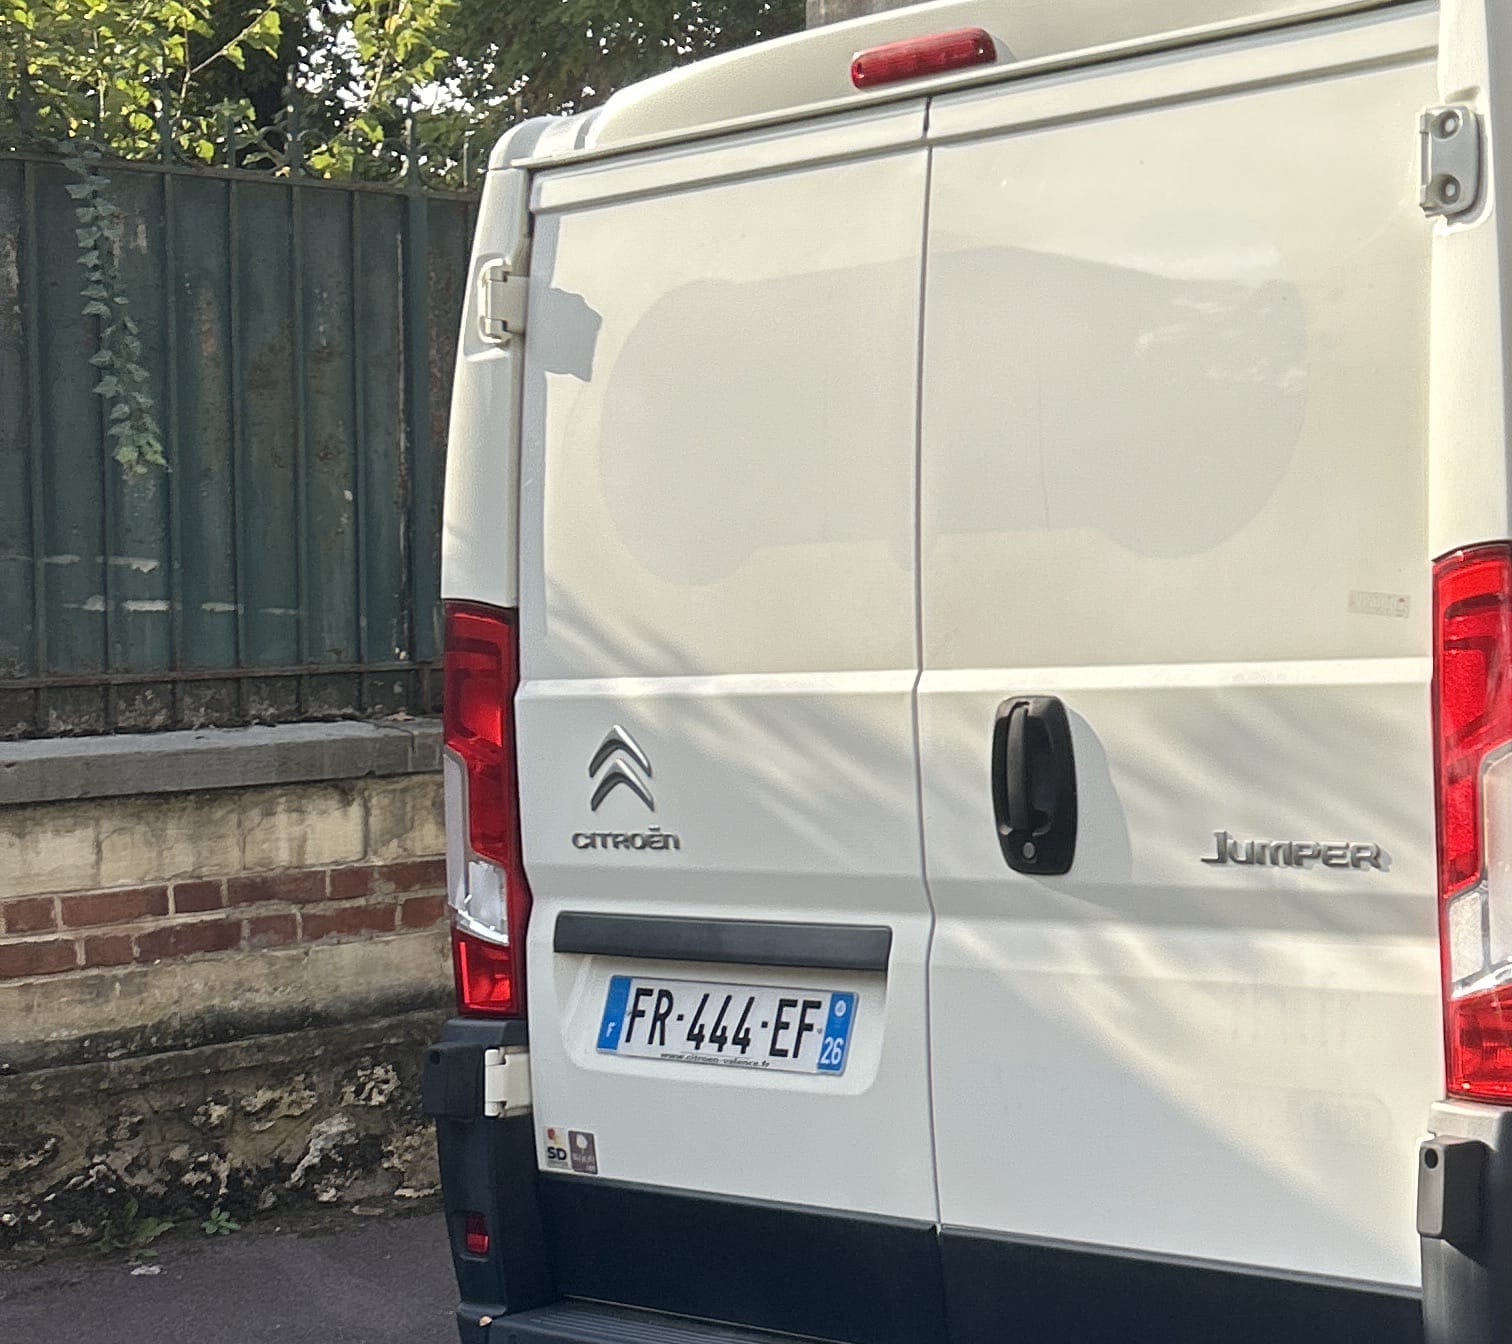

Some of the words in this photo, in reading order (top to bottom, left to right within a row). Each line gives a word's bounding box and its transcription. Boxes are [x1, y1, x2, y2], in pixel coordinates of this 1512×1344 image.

[623, 986, 823, 1060] FR-444-EF
[820, 1036, 844, 1065] 26
[547, 1146, 567, 1161] SD
